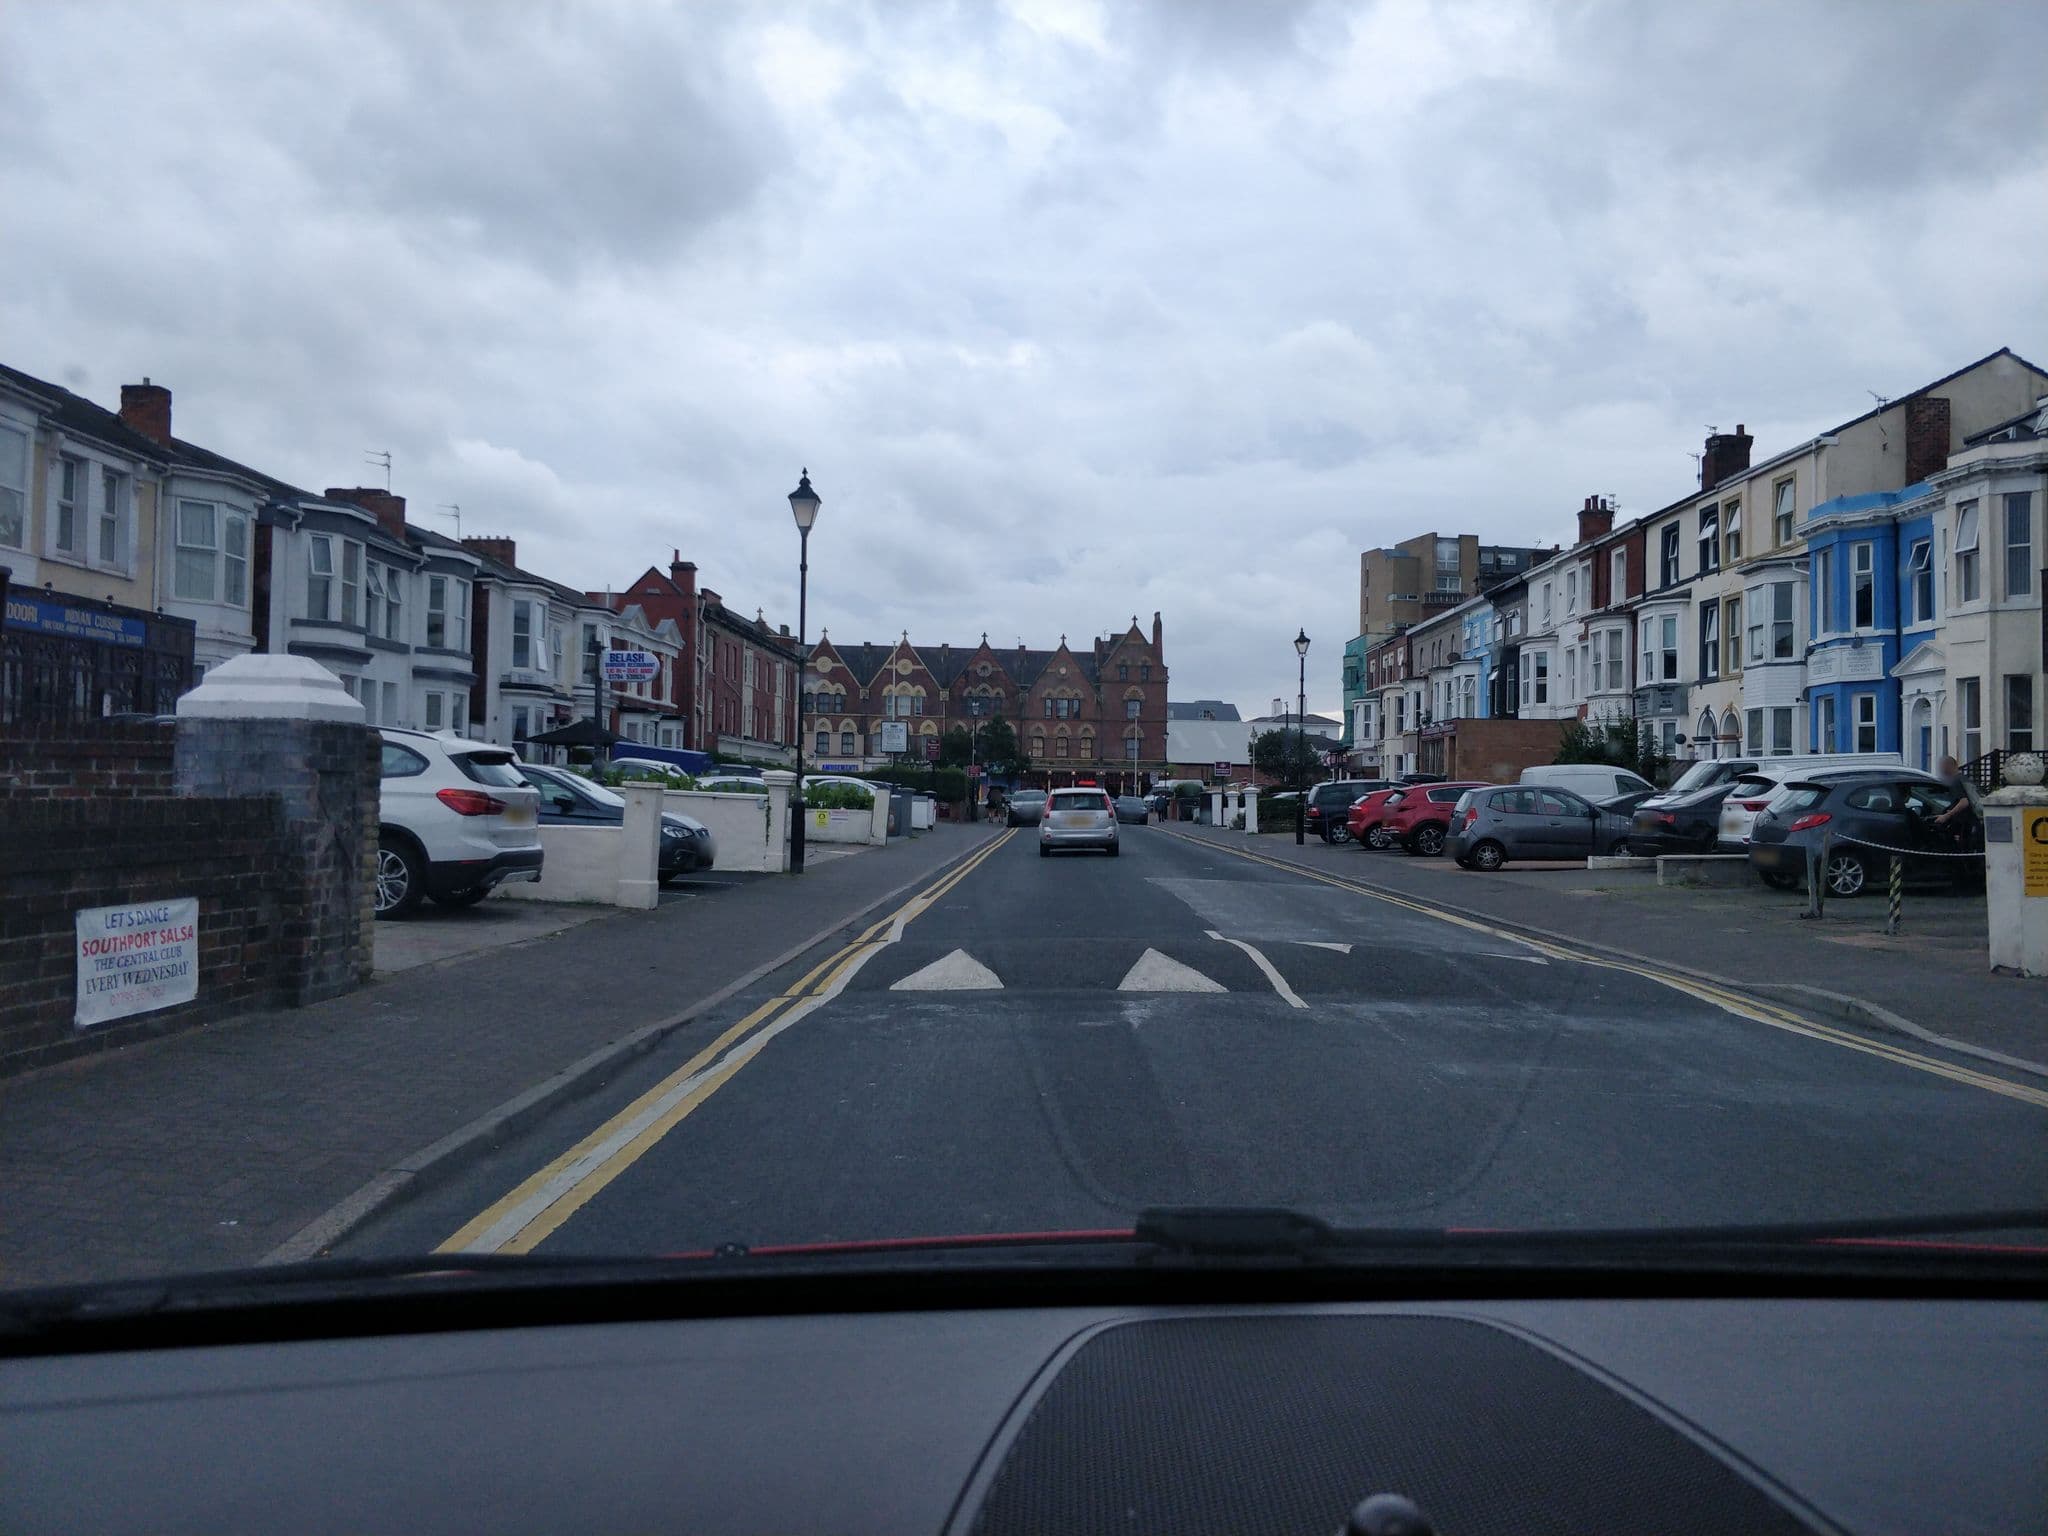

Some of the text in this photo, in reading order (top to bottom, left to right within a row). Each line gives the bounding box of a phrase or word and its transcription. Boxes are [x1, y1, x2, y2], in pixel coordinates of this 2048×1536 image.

[64, 608, 92, 626] INDIAN
[609, 652, 645, 663] BELASH
[104, 907, 169, 929] LET'S DANCE
[82, 925, 194, 957] SOUTHPORT SALSA
[95, 945, 183, 972] THE CENTRAL CLUB
[85, 960, 190, 995] EVERY WEDNESDAY
